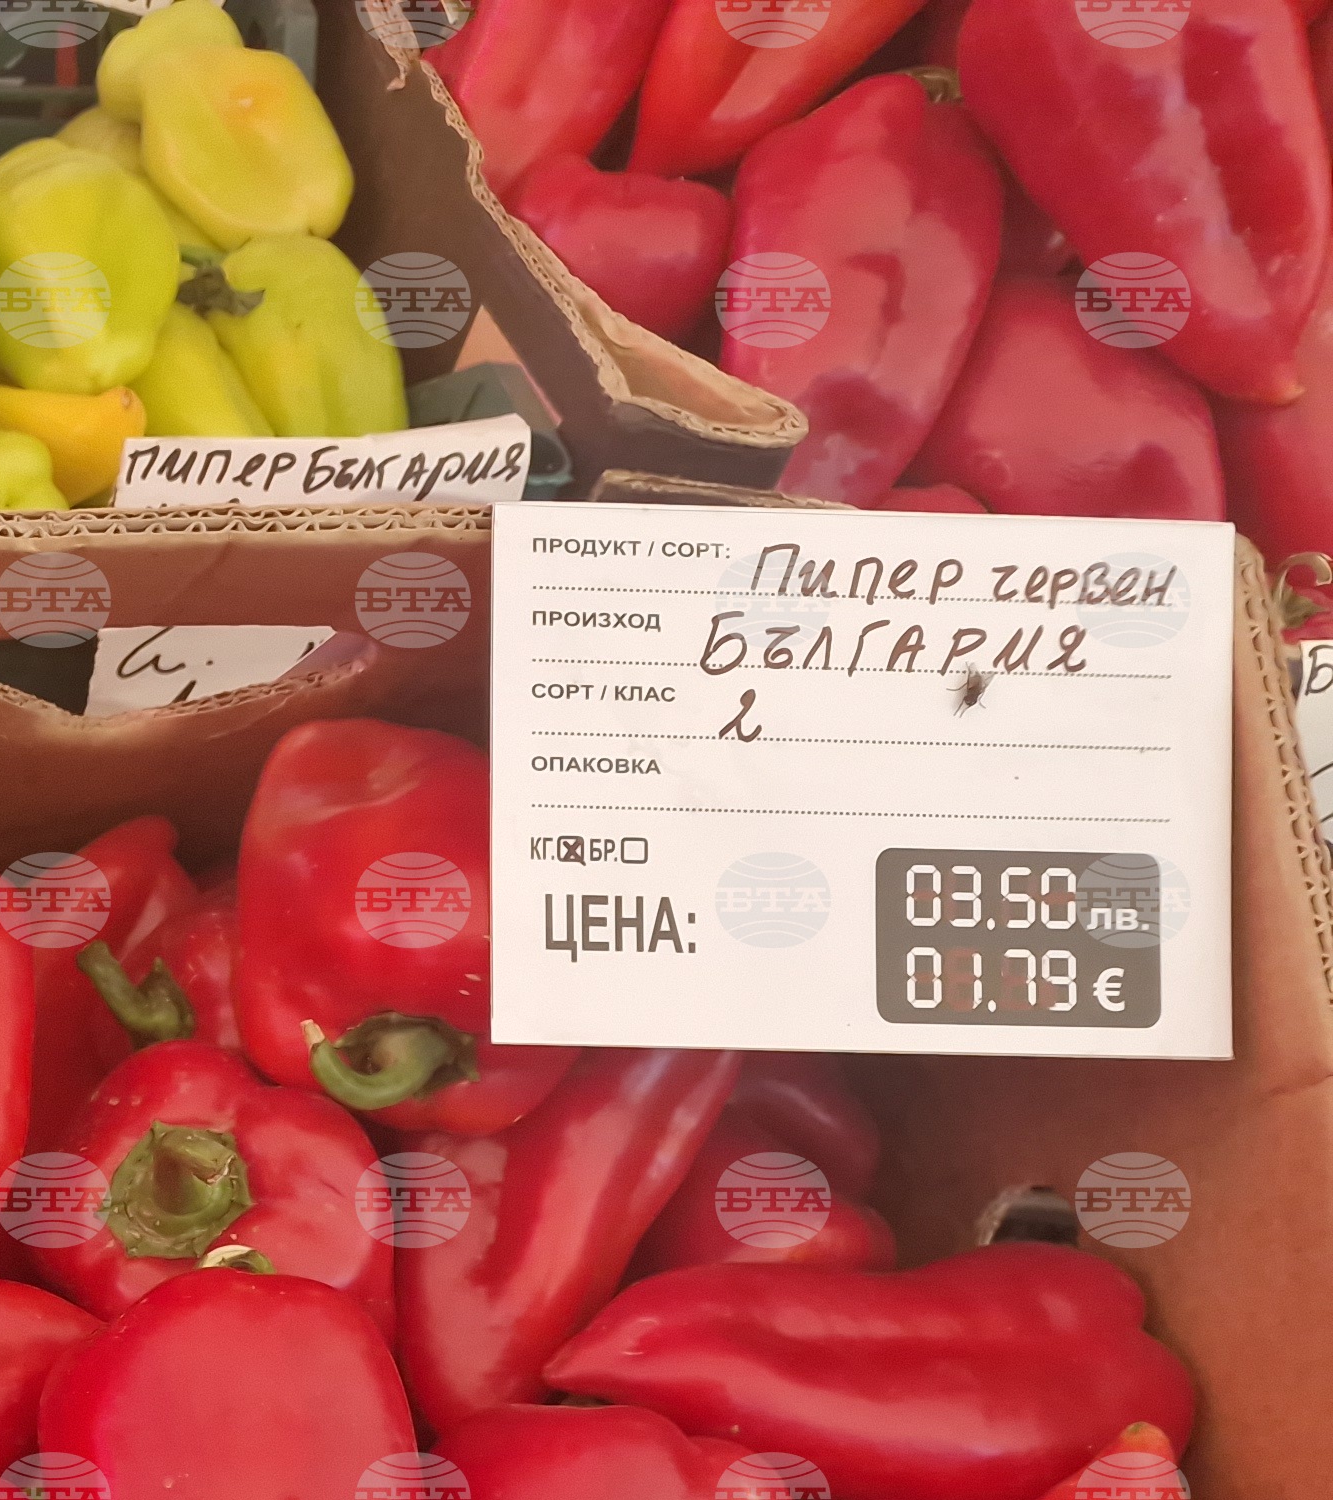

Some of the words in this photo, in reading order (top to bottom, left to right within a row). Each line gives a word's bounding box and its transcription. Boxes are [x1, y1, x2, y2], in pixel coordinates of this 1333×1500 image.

[532, 537, 641, 557] ПРОДУКТ
[647, 541, 654, 557] /
[661, 541, 731, 559] СОРТ:
[532, 610, 662, 632] ПРОИЗХОД
[531, 683, 595, 700] СОРТ
[600, 685, 607, 700] /
[614, 685, 676, 702] КЛАС
[718, 688, 763, 743] 2
[531, 755, 662, 775] ОПАКОВКА
[589, 838, 618, 862] БР.
[906, 864, 1077, 931] 03.50
[1086, 907, 1150, 931] лв.
[544, 893, 697, 963] ЦЕНА:
[906, 947, 1077, 1013] 01.79
[1092, 967, 1126, 1012] €
